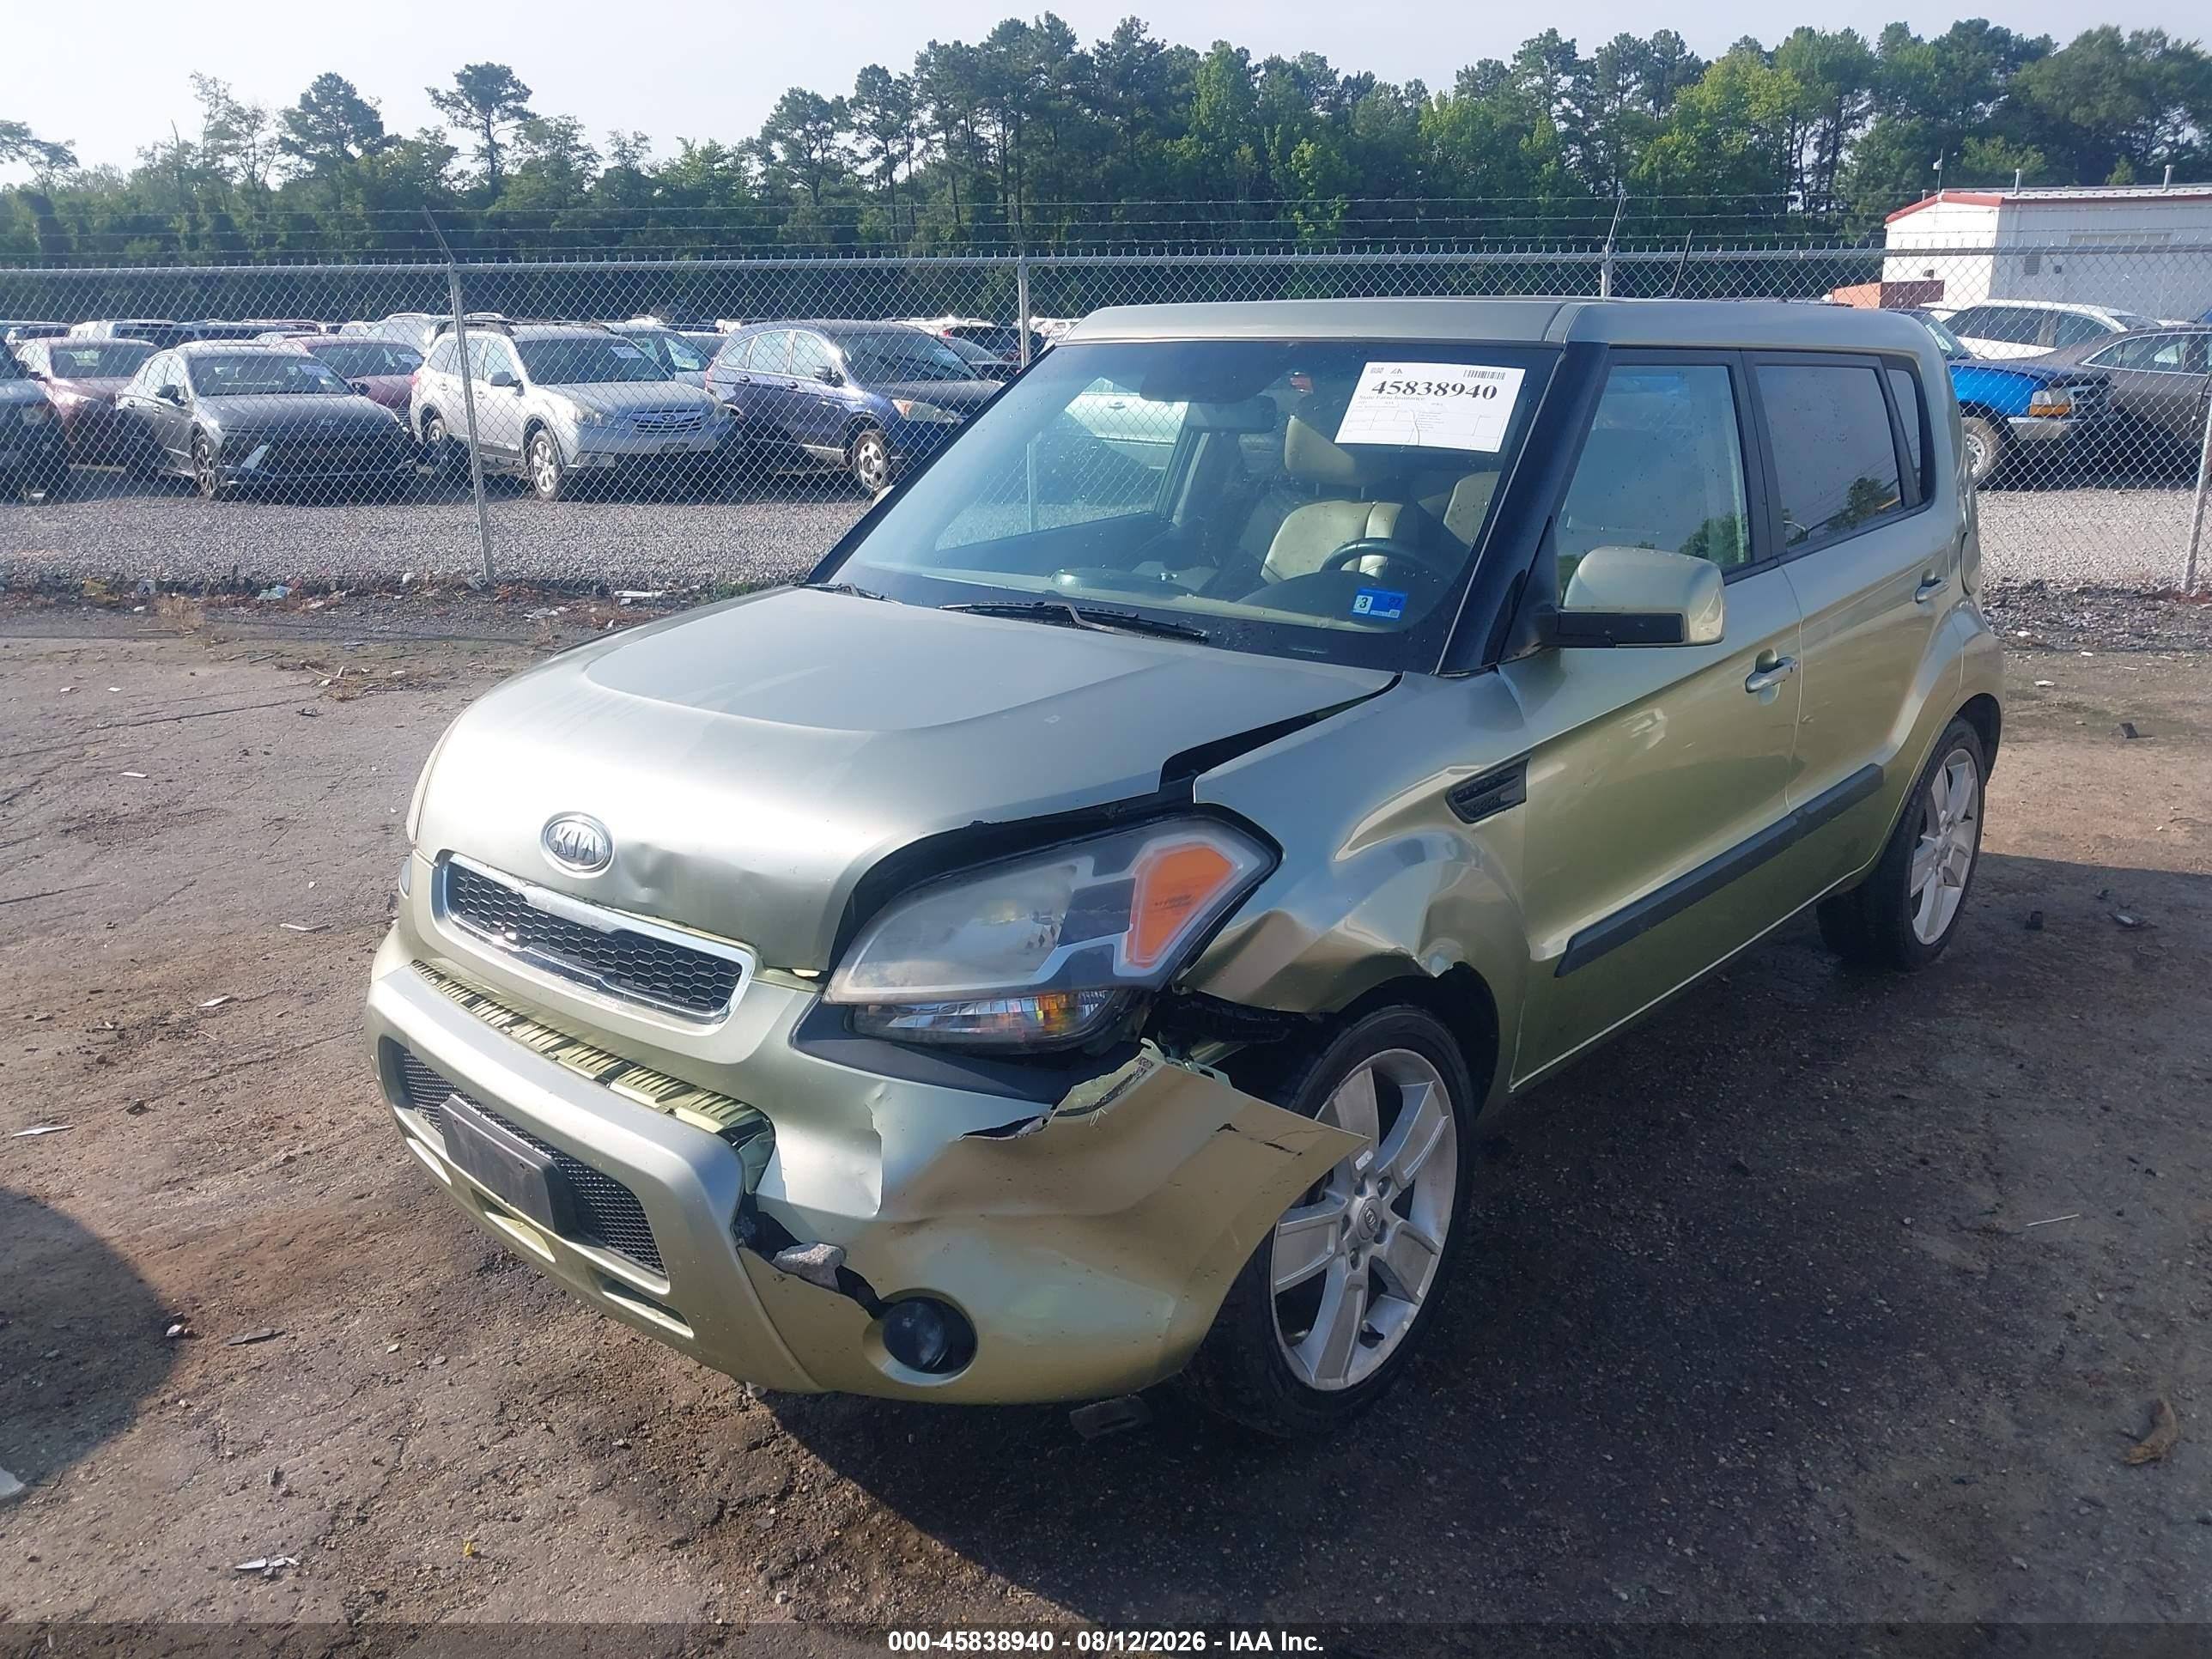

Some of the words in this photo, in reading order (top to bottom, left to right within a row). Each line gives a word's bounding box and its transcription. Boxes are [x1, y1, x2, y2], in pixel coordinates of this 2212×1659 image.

[1371, 380, 1498, 400] 45838940
[1359, 597, 1368, 609] 3
[552, 823, 599, 864] KIA
